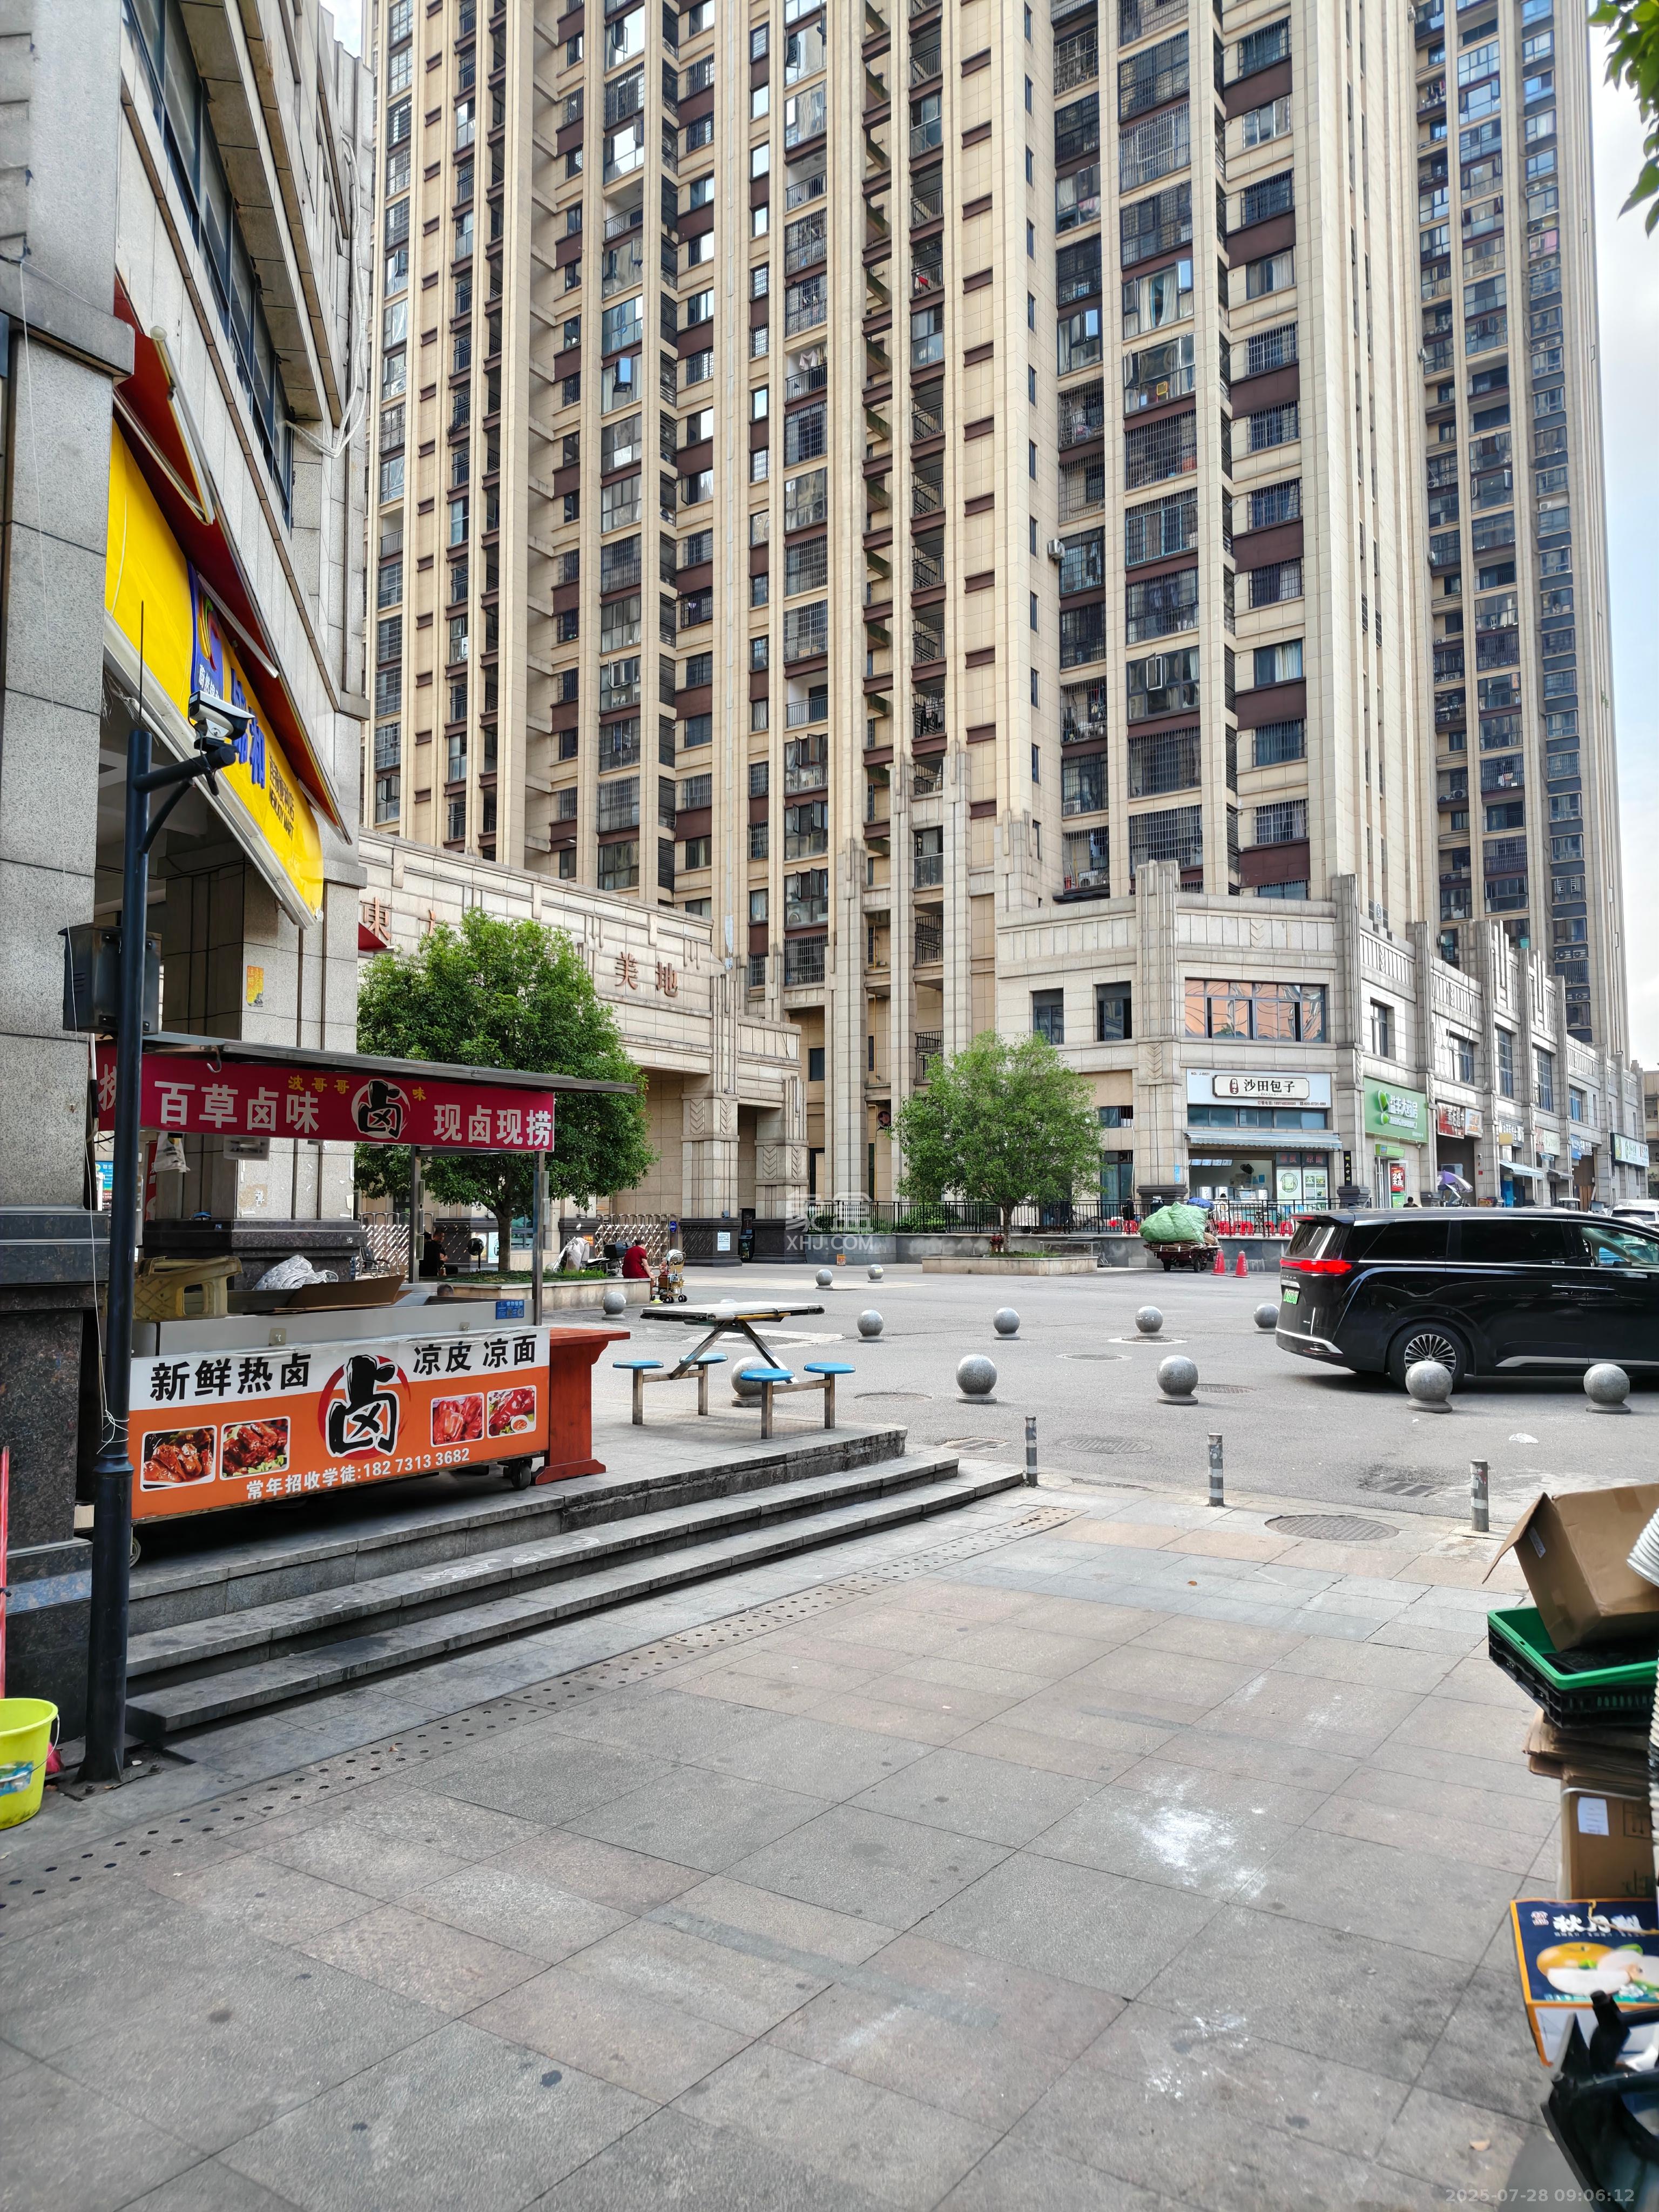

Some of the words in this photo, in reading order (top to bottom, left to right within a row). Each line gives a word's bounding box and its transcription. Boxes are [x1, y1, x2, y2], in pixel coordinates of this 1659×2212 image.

[616, 951, 679, 997] 美地
[1243, 1078, 1296, 1094] 沙田包子
[154, 1081, 320, 1134] 百草卤味
[433, 1103, 552, 1147] 现卤现捞
[149, 1352, 312, 1401] 新鲜热卤
[412, 1341, 473, 1375] 凉皮
[482, 1334, 538, 1368] 凉面
[327, 1354, 397, 1455] 卤
